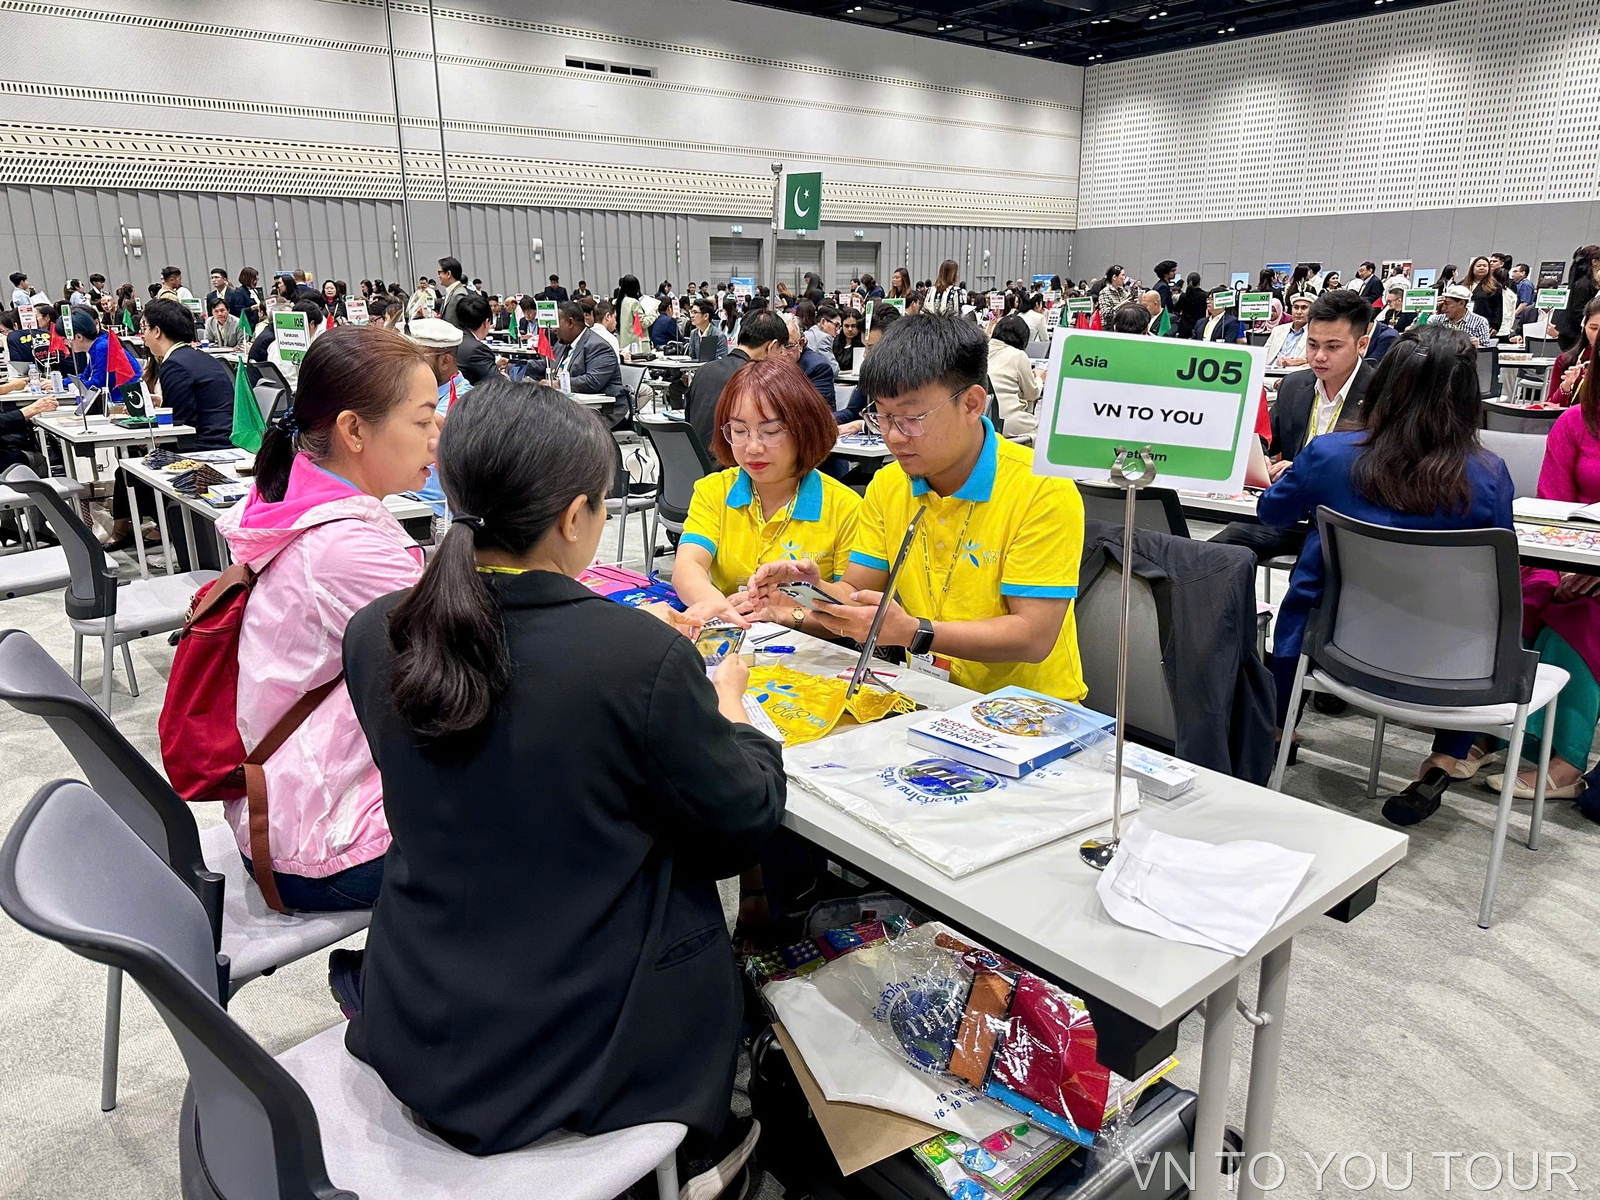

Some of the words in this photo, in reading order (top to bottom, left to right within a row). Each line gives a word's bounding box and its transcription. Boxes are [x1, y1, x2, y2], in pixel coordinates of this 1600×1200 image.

[1070, 354, 1108, 368] Asia
[1176, 357, 1243, 385] J05
[1092, 402, 1122, 418] VN
[1127, 406, 1154, 420] TO
[1160, 409, 1204, 425] YOU
[929, 726, 984, 744] ANNUAL
[930, 720, 992, 742] DIRECTORY
[936, 1093, 948, 1104] 15
[934, 1109, 945, 1120] 16
[950, 1100, 962, 1110] 19
